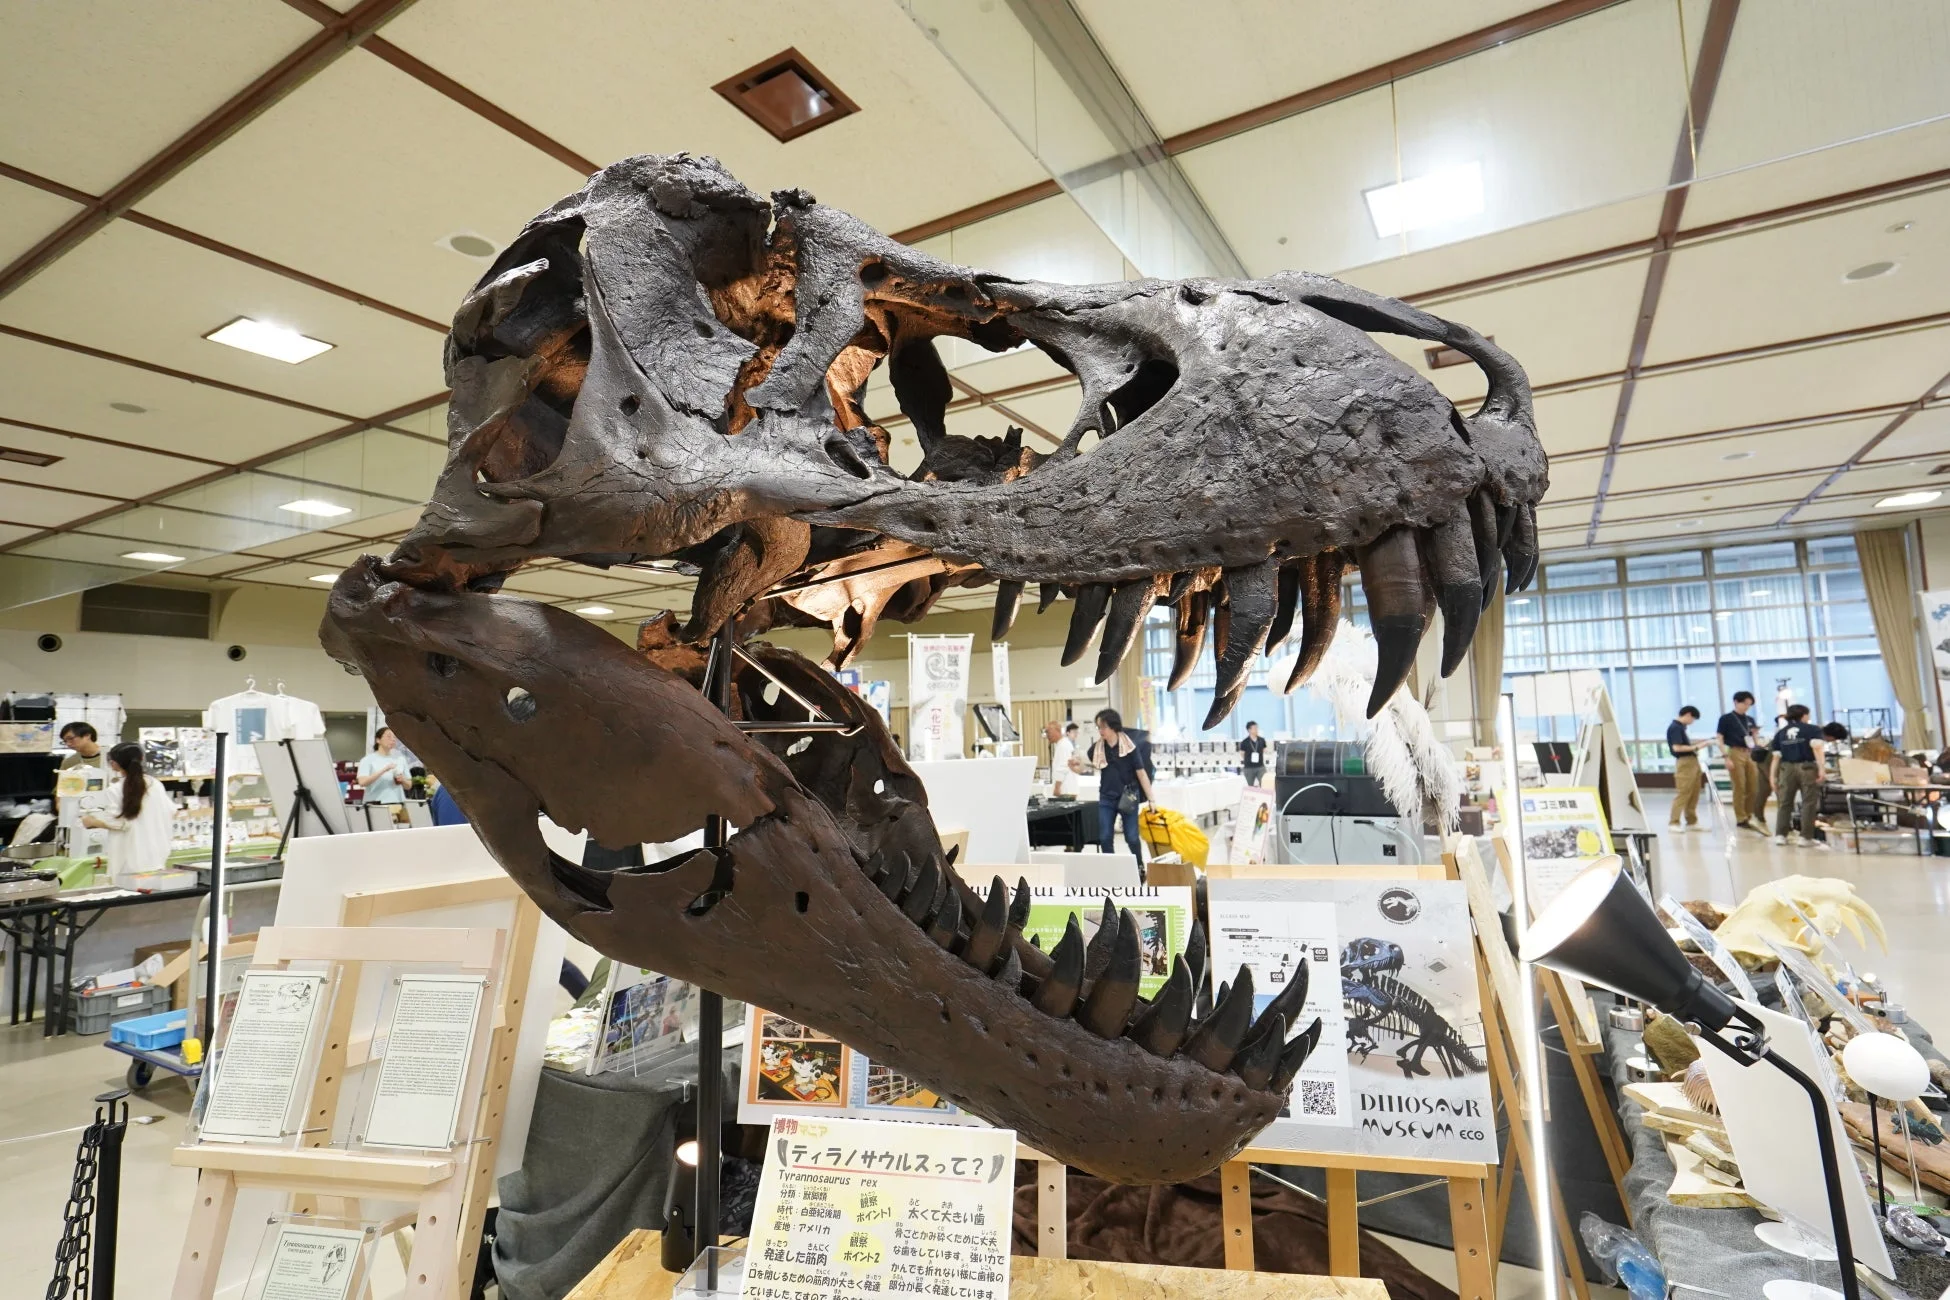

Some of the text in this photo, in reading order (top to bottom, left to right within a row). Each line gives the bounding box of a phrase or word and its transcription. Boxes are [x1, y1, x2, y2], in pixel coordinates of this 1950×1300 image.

[1362, 1118, 1455, 1140] MUSEUM
[792, 1144, 984, 1176] ティラノサウルスって？
[778, 1169, 878, 1188] Tyrannosaurus rex
[860, 1196, 878, 1208] 観察
[908, 1207, 986, 1226] 太くて大きい歯
[849, 1236, 868, 1248] 観察
[763, 1247, 828, 1267] 発達した筋肉
